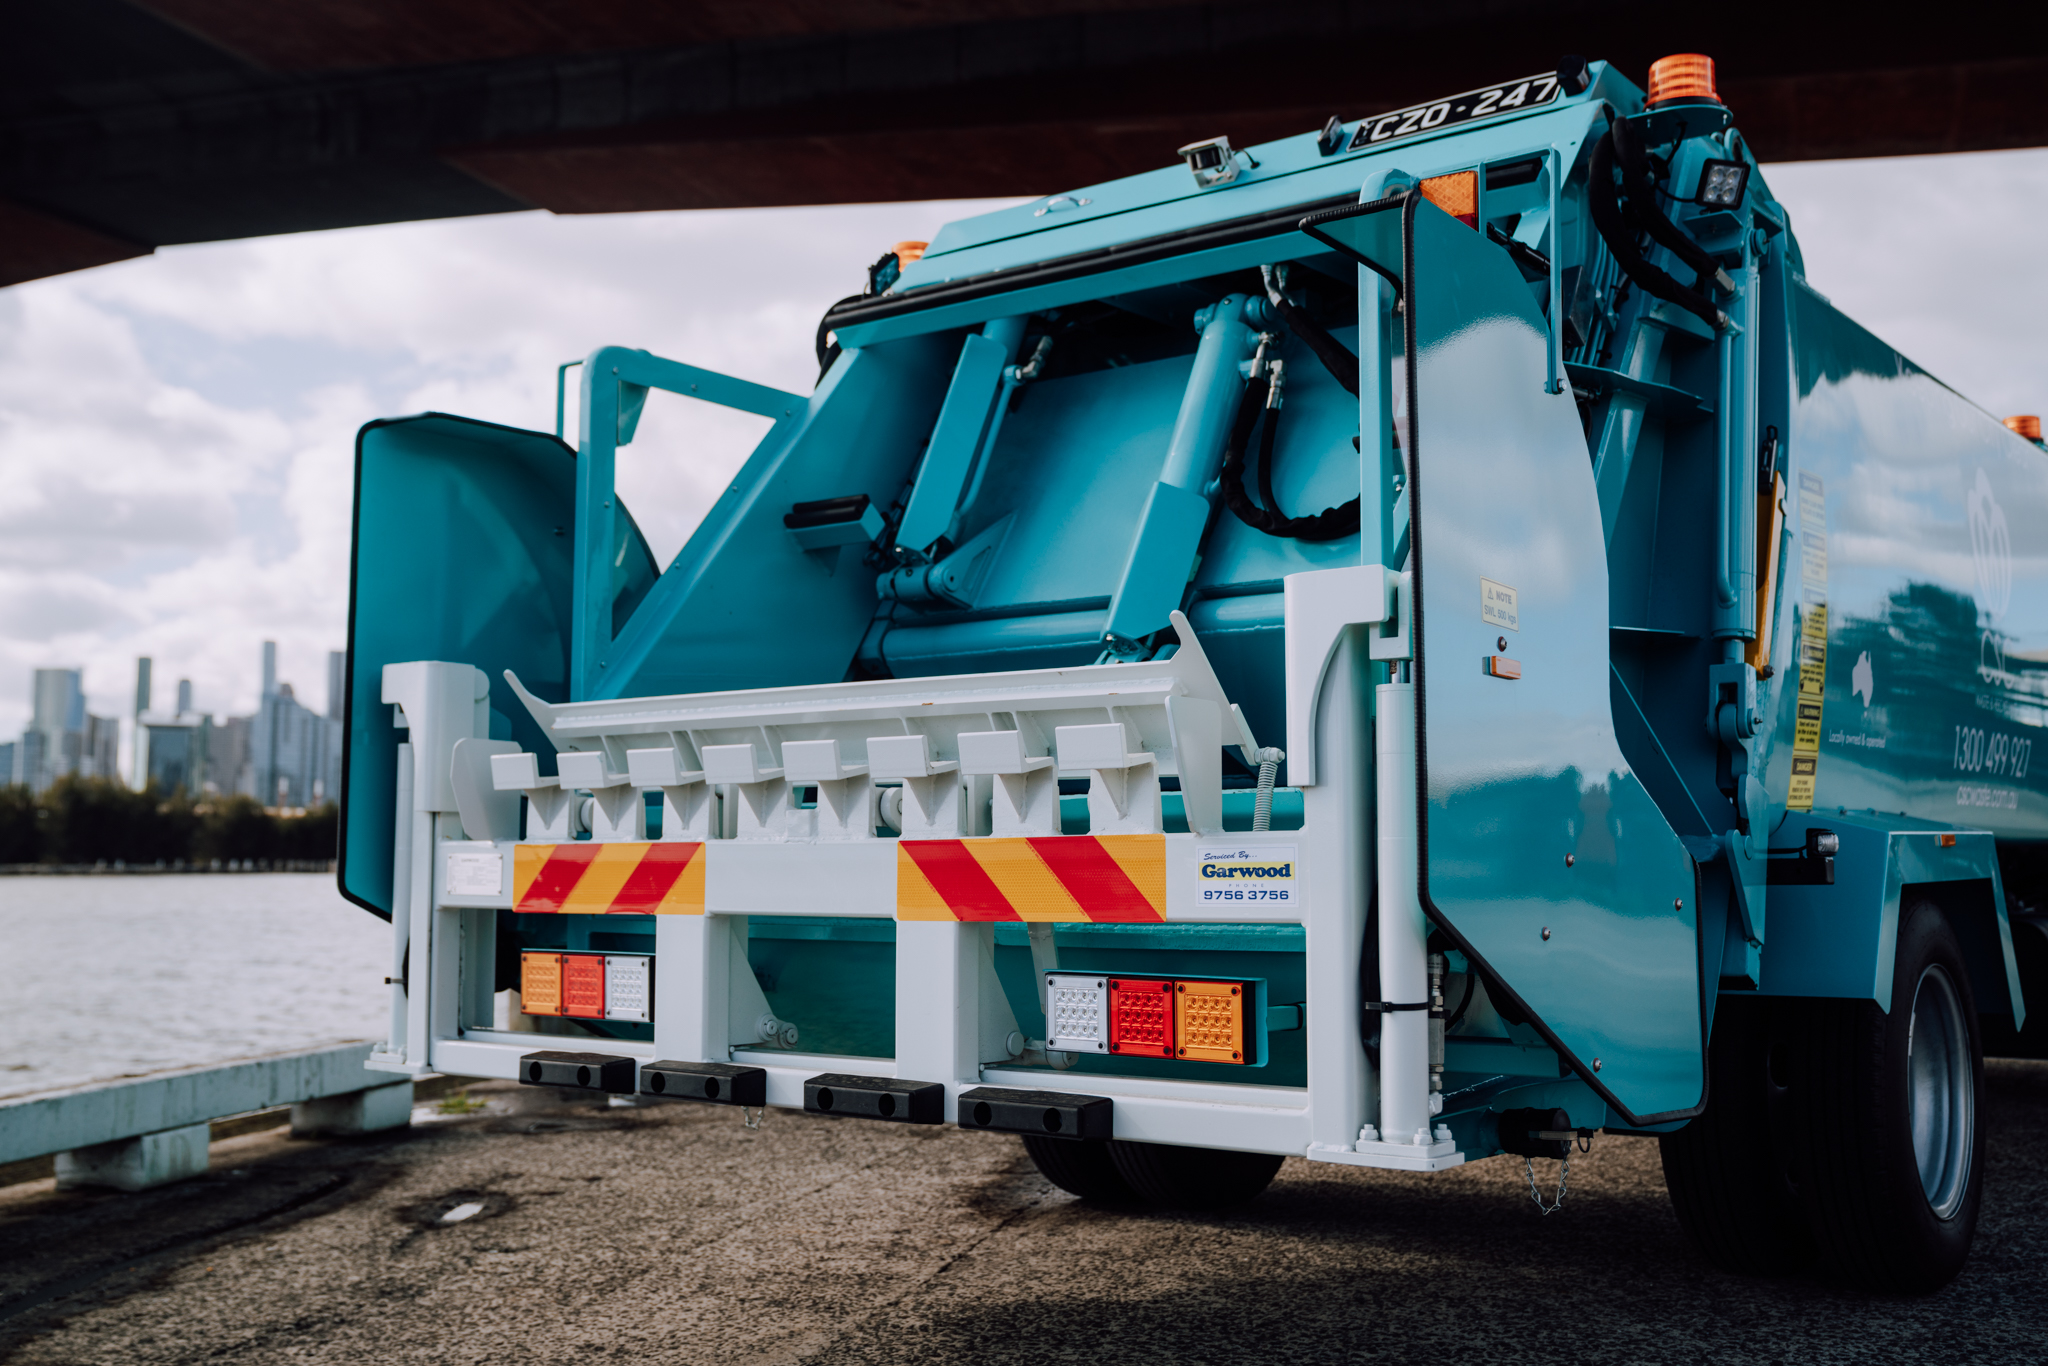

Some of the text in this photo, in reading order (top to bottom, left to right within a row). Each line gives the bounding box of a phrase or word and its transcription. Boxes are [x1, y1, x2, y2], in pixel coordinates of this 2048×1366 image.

[1496, 590, 1512, 605] NOTE
[1484, 604, 1496, 618] SWL
[1497, 608, 1507, 621] 500
[1828, 728, 1845, 747] Locally
[1846, 731, 1862, 746] owned
[1866, 735, 1887, 751] operated
[1953, 724, 2032, 779] 1300 499 927
[1203, 851, 1236, 861] Serviced
[1201, 863, 1292, 878] Garwood
[1203, 890, 1290, 900] 9756 3756
